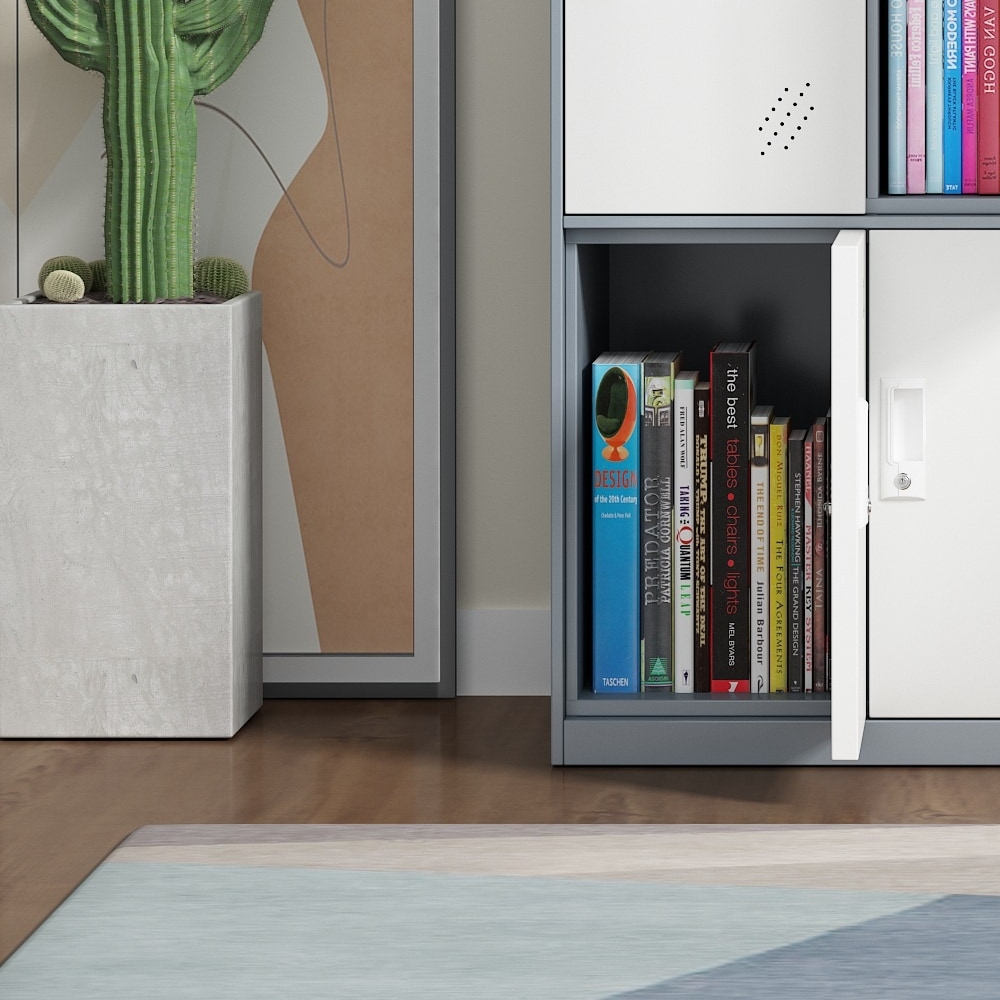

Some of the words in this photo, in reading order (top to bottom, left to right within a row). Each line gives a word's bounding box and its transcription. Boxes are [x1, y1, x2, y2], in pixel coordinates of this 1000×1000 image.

[727, 369, 738, 392] the
[727, 397, 738, 429] best
[594, 470, 637, 488] DESIGN
[727, 438, 739, 488] tables
[594, 495, 600, 503] of
[600, 495, 608, 503] the
[609, 495, 619, 503] 20th
[620, 495, 638, 505] Century
[660, 477, 670, 543] CORNWELL
[680, 485, 689, 517] TAKING
[644, 476, 660, 606] PREDATOR
[727, 506, 740, 555] chairs
[756, 529, 764, 542] OF
[676, 526, 693, 580] QUANTUM
[660, 546, 670, 604] PATRICIA
[700, 565, 705, 582] OF
[680, 585, 690, 616] LEAP
[724, 572, 740, 615] lights
[602, 678, 628, 686] TASCHEN
